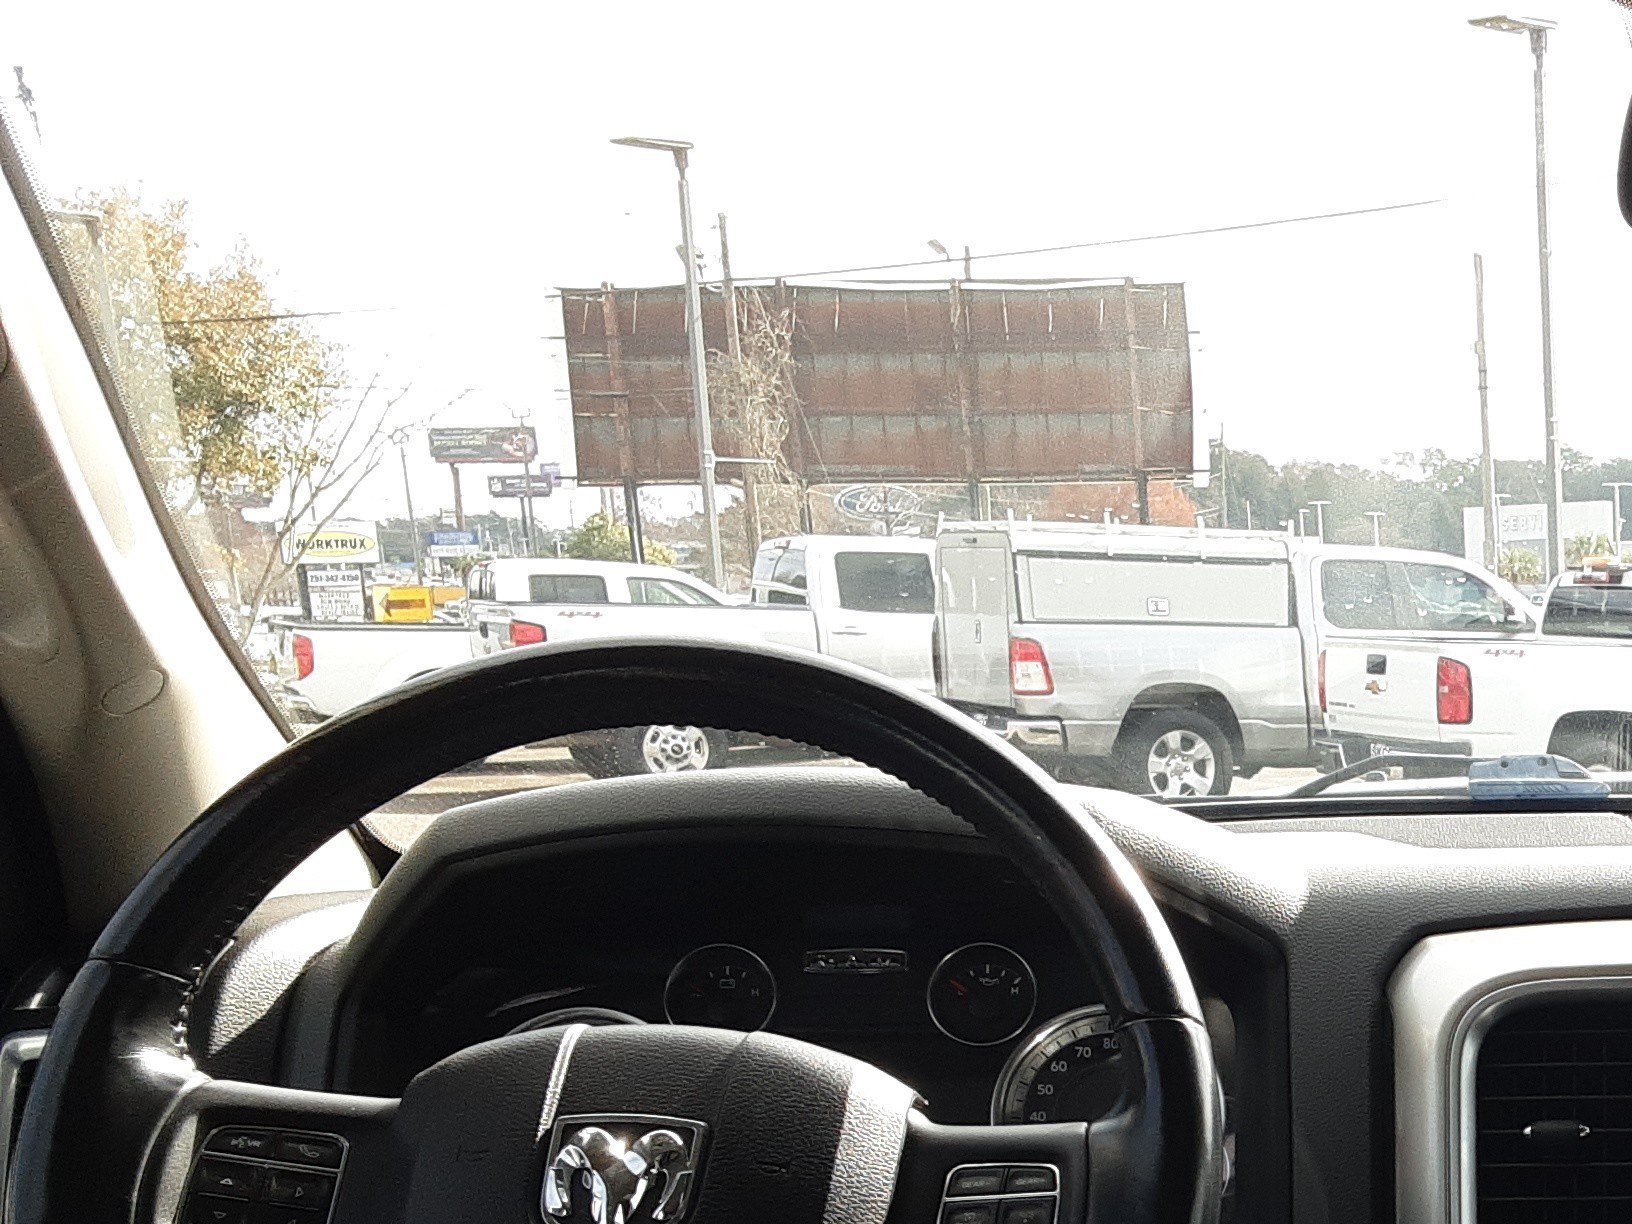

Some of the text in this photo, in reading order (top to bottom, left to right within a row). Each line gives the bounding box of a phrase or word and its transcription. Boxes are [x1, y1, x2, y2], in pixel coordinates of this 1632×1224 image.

[1502, 514, 1544, 531] SERVI
[1102, 1037, 1119, 1049] 80
[1075, 1046, 1092, 1059] 70
[1050, 1060, 1068, 1072] 60
[1037, 1084, 1054, 1095] 50
[1030, 1110, 1047, 1122] 40
